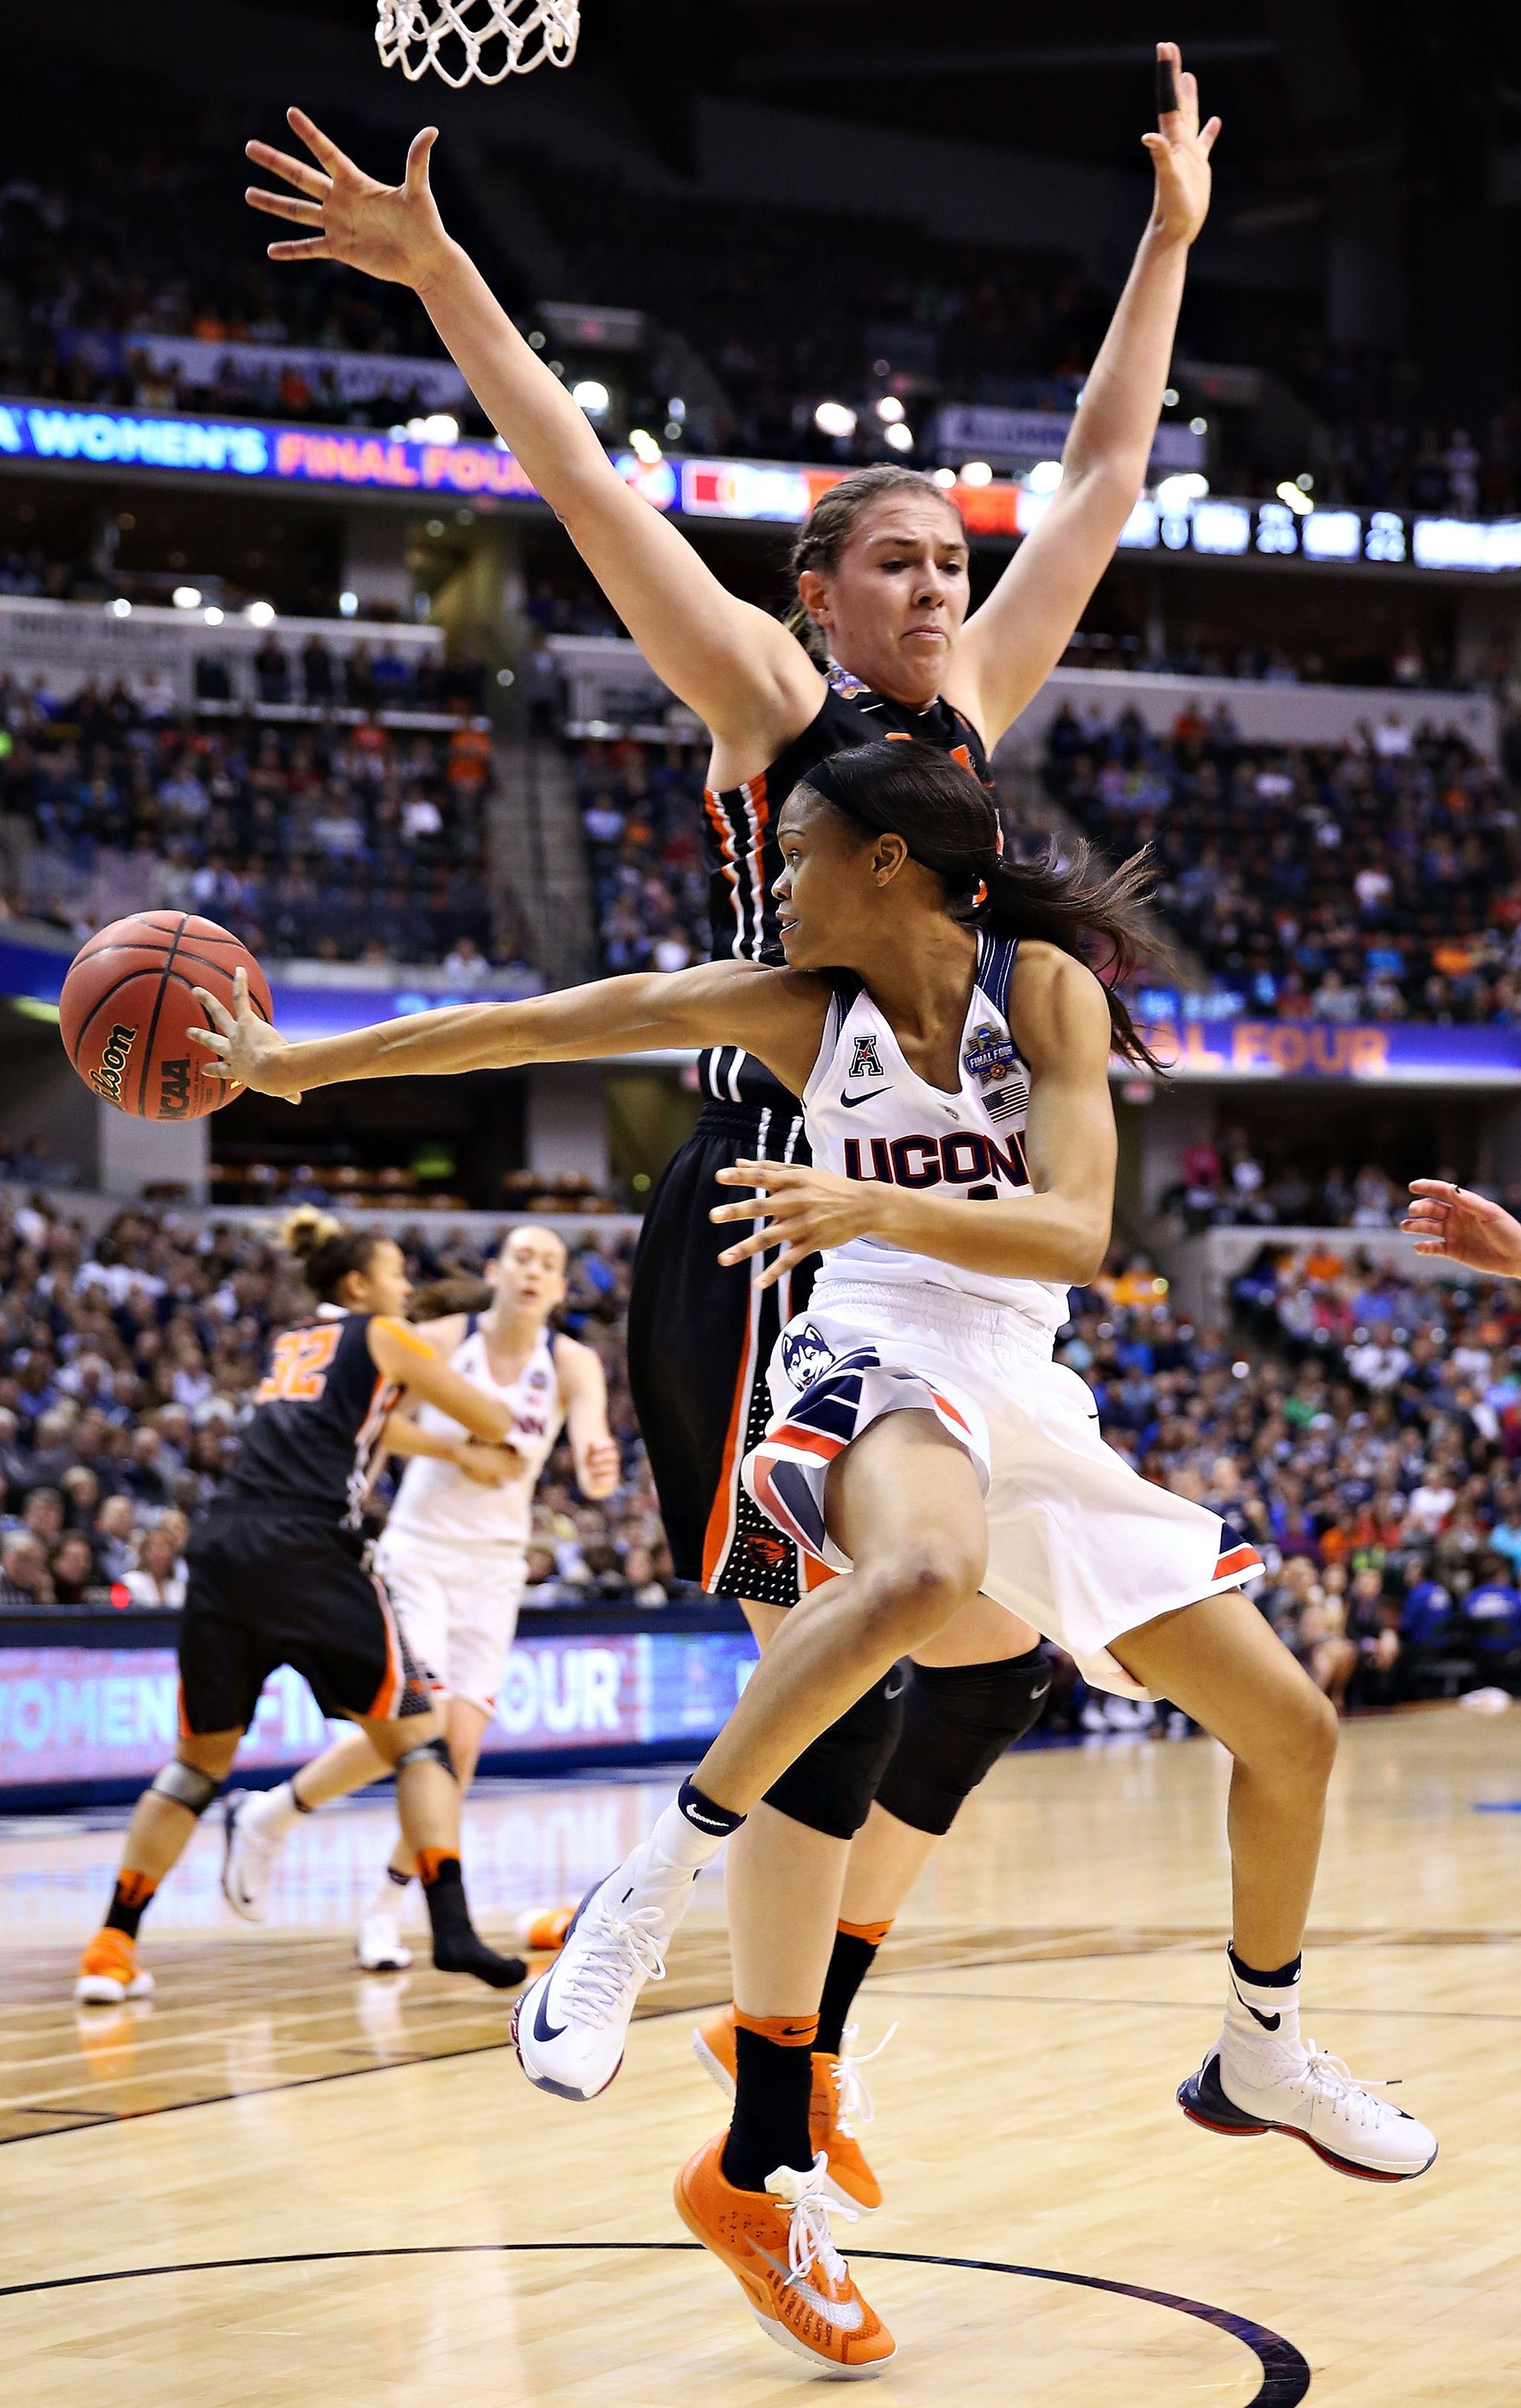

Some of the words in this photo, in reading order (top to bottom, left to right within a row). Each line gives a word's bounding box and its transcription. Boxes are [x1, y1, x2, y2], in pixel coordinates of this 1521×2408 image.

[27, 408, 268, 474] WOMEN'S
[277, 432, 420, 488] FINAL
[421, 447, 540, 498] FOU
[969, 1051, 993, 1068] FINAL
[993, 1045, 1014, 1059] FOUR
[1231, 1022, 1389, 1077] FOUR
[844, 1130, 1031, 1190] UCON
[254, 1323, 345, 1405] 32
[0, 1675, 179, 1752] OMEN
[496, 1646, 623, 1734] OUR
